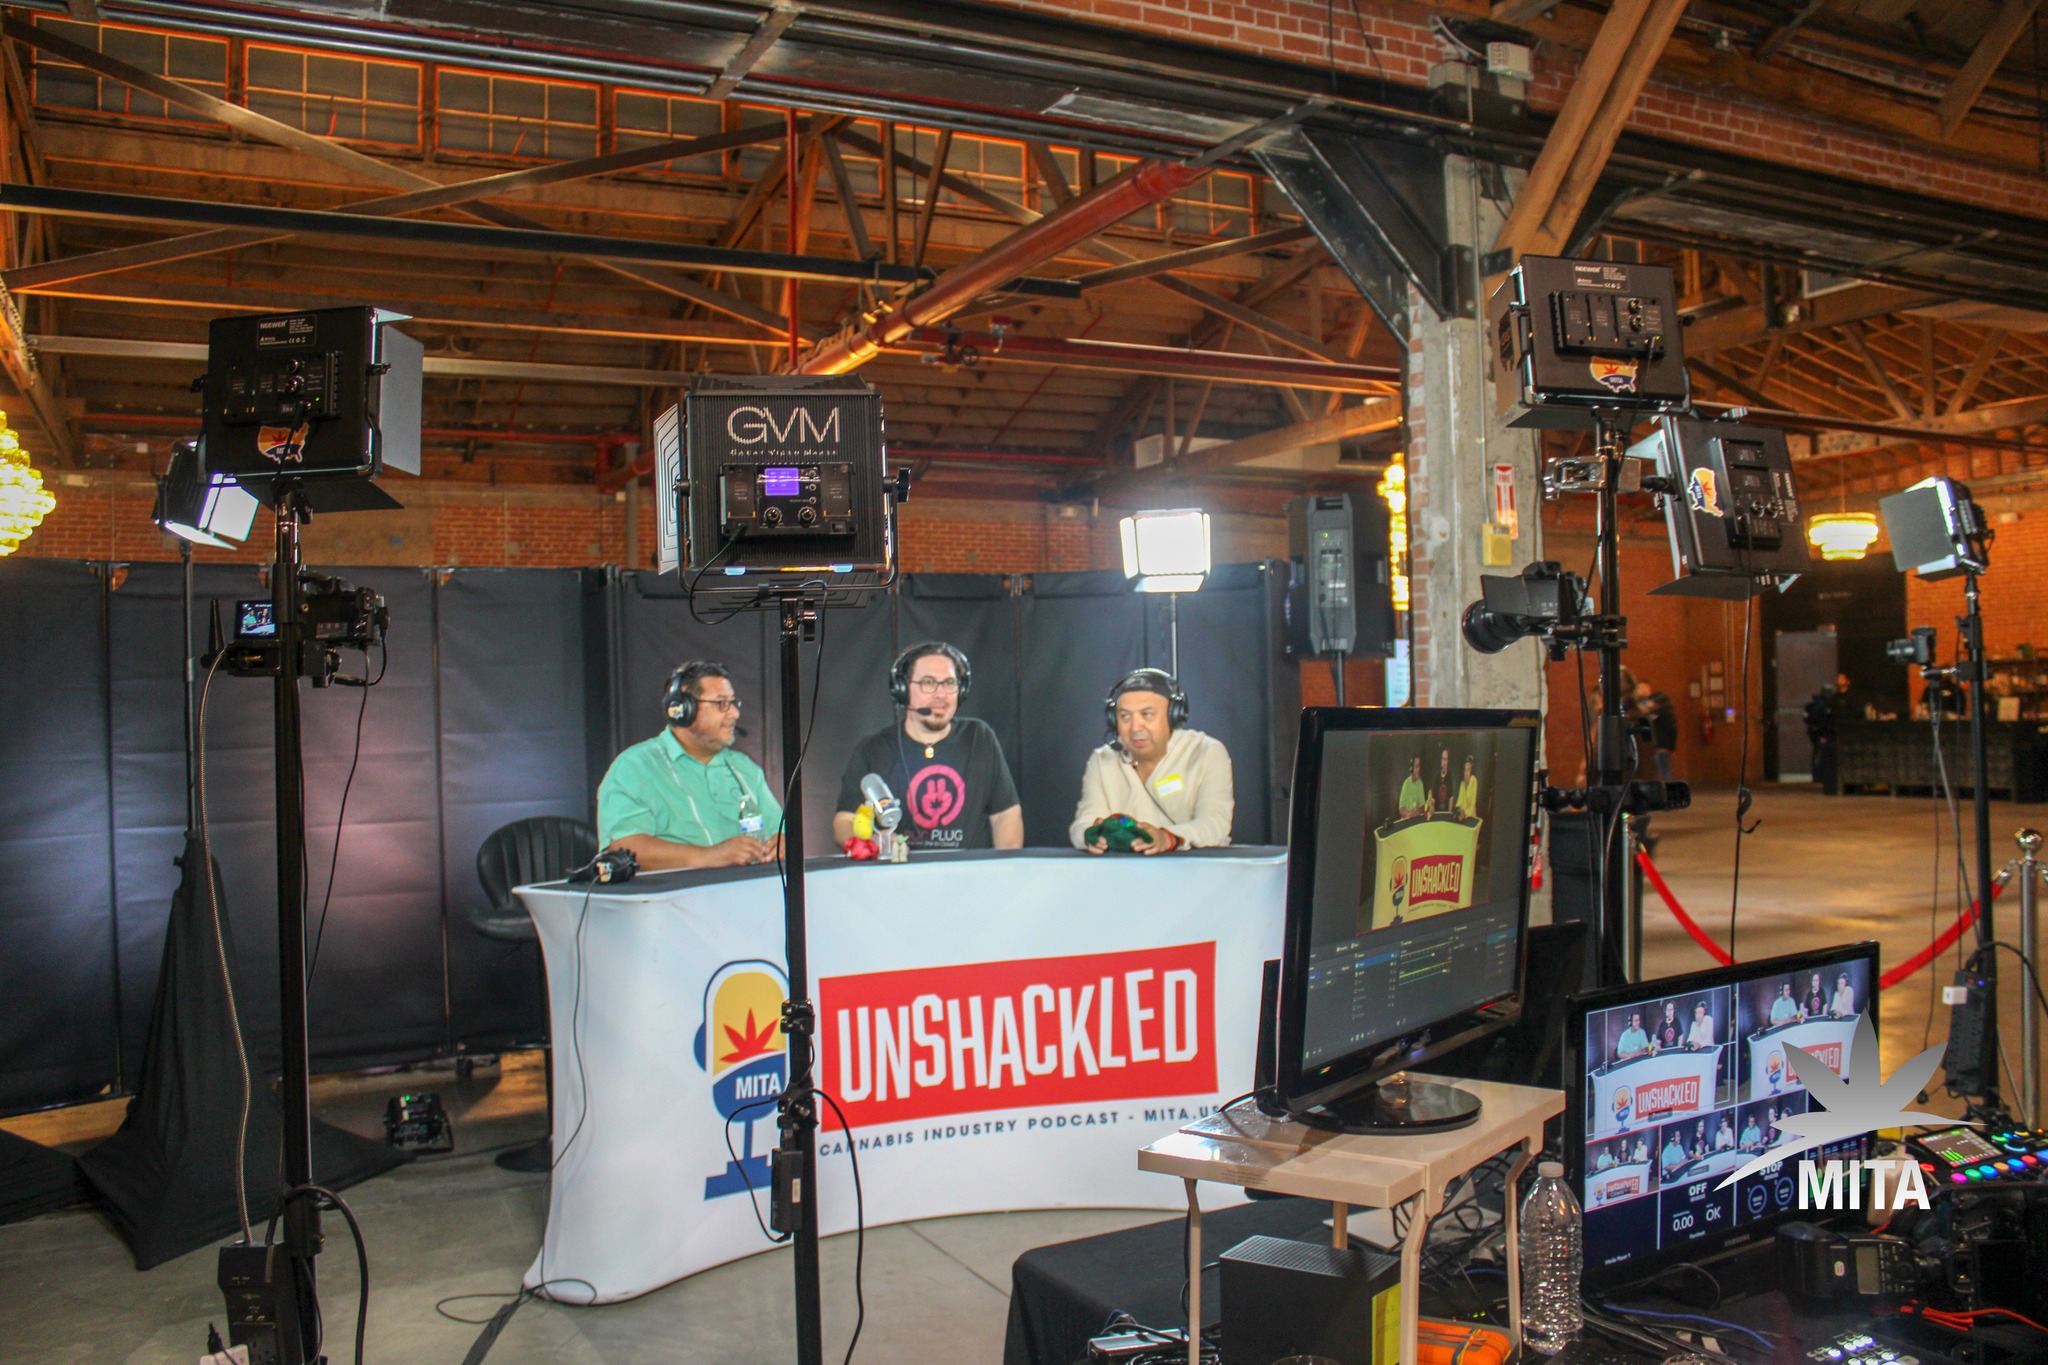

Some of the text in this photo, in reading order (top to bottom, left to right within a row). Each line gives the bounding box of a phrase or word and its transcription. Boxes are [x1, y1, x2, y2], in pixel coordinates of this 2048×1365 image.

[727, 406, 840, 444] GVM
[931, 829, 963, 841] PLUG
[1411, 861, 1461, 898] UNSHACKLED
[837, 967, 1199, 1103] UNSHACKLED
[735, 1072, 782, 1100] MITA
[1638, 1081, 1697, 1113] UNSHACKLED
[819, 1131, 914, 1157] CANNABIS
[924, 1119, 1017, 1142] INDUSTRY
[1028, 1111, 1120, 1131] PODCAST
[1759, 1161, 1784, 1176] STOP
[1688, 1182, 1708, 1196] OFF
[1673, 1215, 1694, 1232] 0.00
[1705, 1206, 1721, 1221] OK
